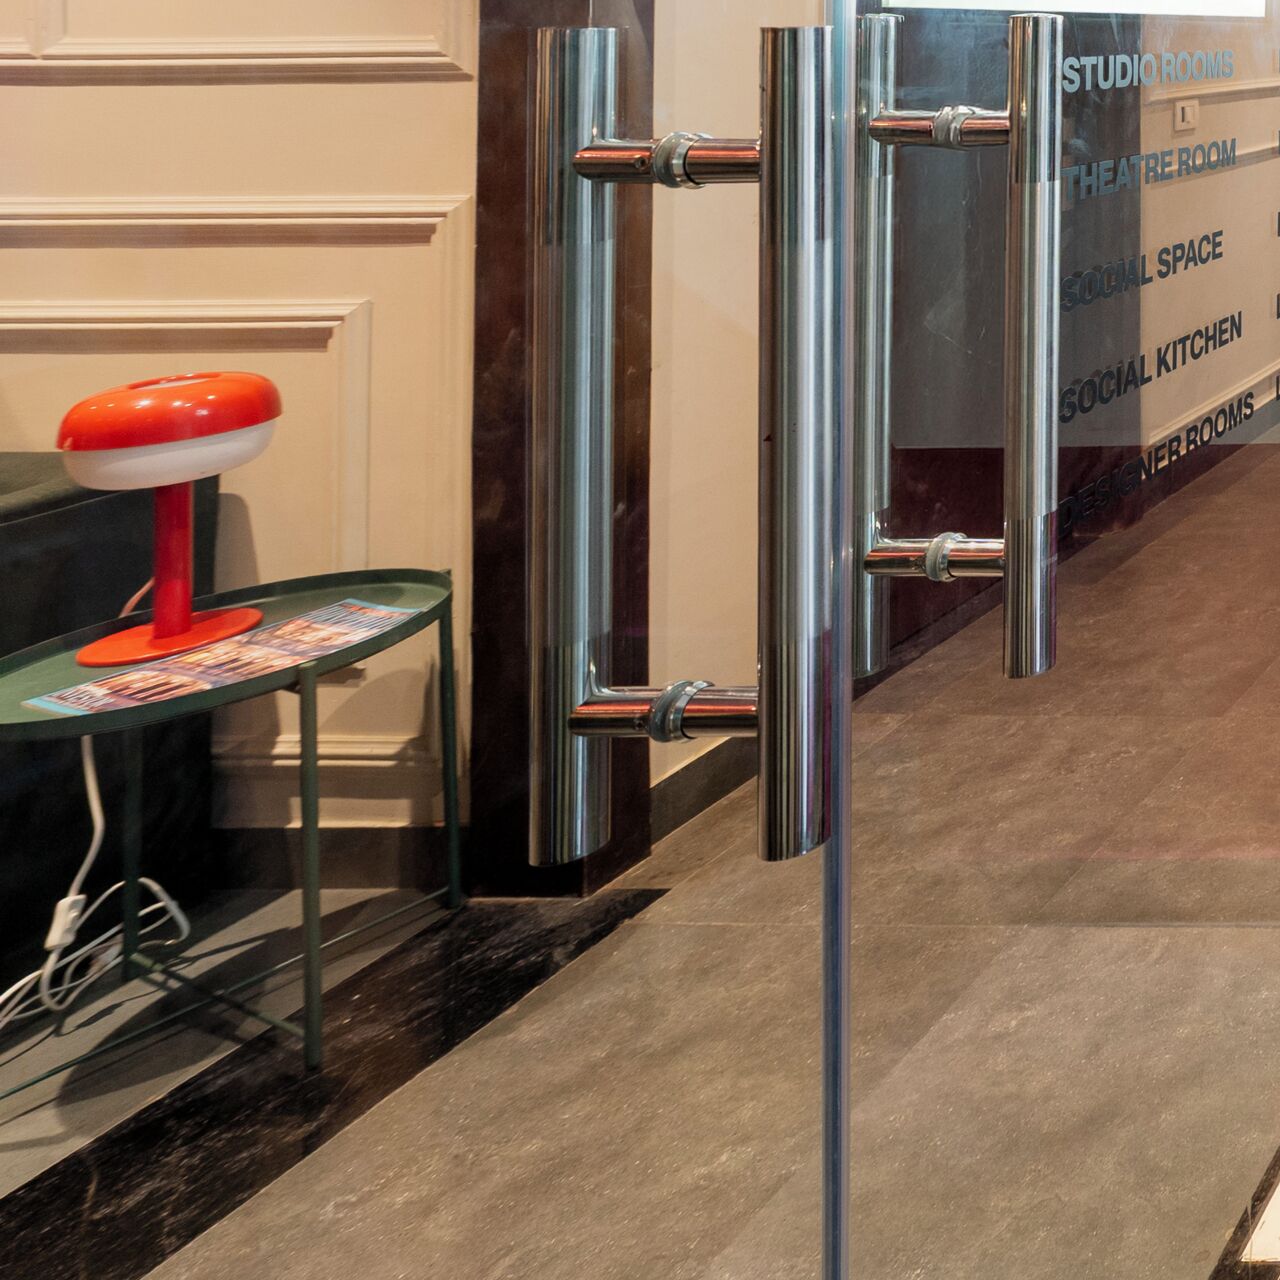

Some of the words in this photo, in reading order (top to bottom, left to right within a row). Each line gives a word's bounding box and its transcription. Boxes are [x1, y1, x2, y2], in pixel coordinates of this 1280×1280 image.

[1062, 53, 1157, 94] STUDIO
[1160, 50, 1234, 84] ROOMS
[1061, 149, 1174, 202] THEATRE
[1178, 138, 1237, 177] ROOM
[1060, 254, 1153, 313] SOCIAL
[1157, 230, 1223, 279] SPACE
[1059, 354, 1153, 424] SOCIAL
[1156, 311, 1242, 379] KITCHEN
[1186, 392, 1255, 457] ROOMS
